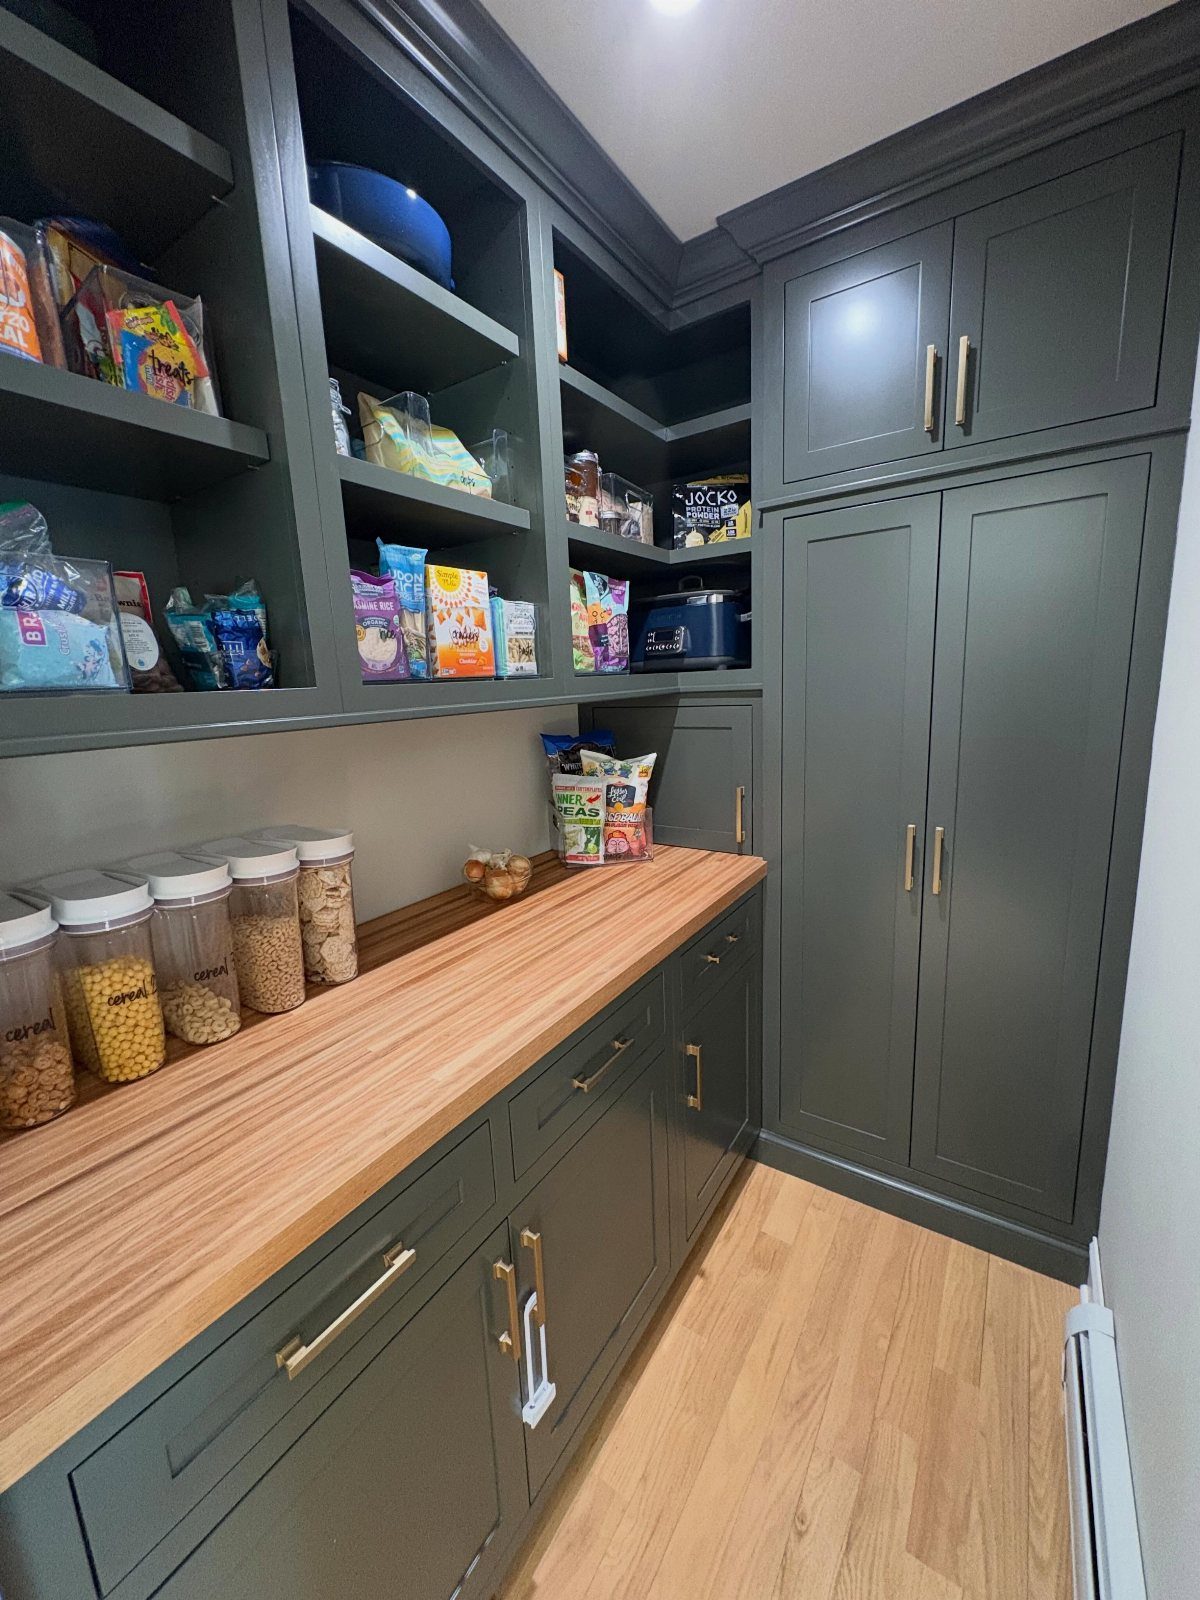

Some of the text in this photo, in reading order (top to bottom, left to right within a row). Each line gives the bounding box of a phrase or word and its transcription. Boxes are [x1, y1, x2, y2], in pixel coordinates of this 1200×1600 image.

[148, 349, 194, 388] treats
[685, 490, 737, 506] JOCKO
[686, 512, 720, 520] POWDER
[380, 601, 395, 611] RICE
[193, 957, 229, 982] cereal
[107, 979, 148, 1007] cereal
[5, 1007, 56, 1042] cereal
